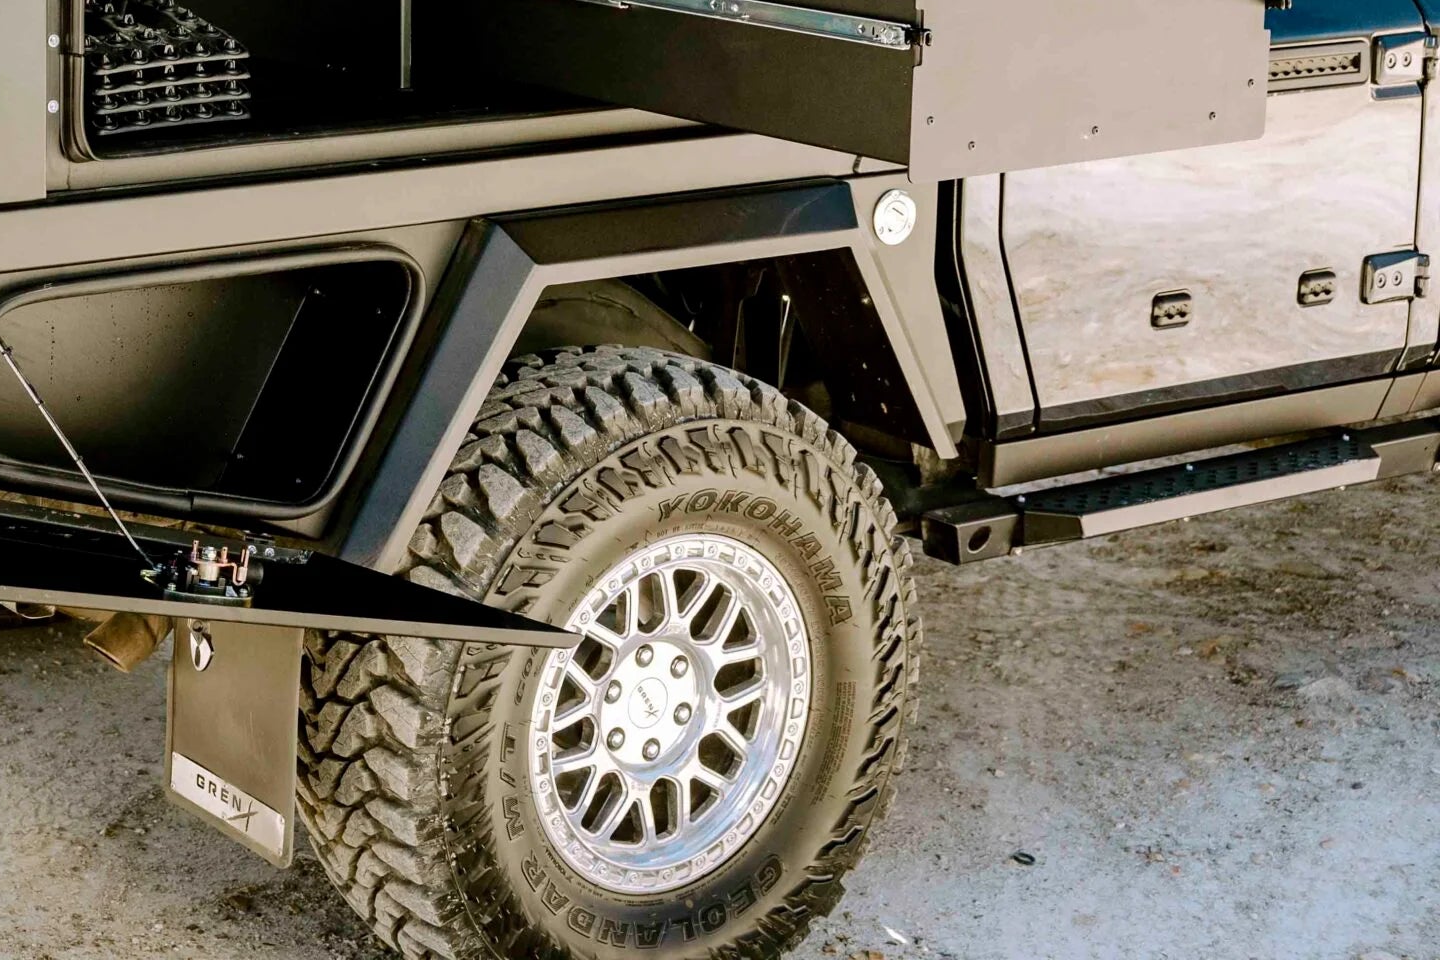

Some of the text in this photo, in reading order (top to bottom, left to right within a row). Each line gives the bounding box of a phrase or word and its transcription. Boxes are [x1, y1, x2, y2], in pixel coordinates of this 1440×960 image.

[658, 488, 853, 627] YOKOHAMA
[500, 721, 525, 841] M/T
[521, 849, 784, 949] GEOLANDAR
